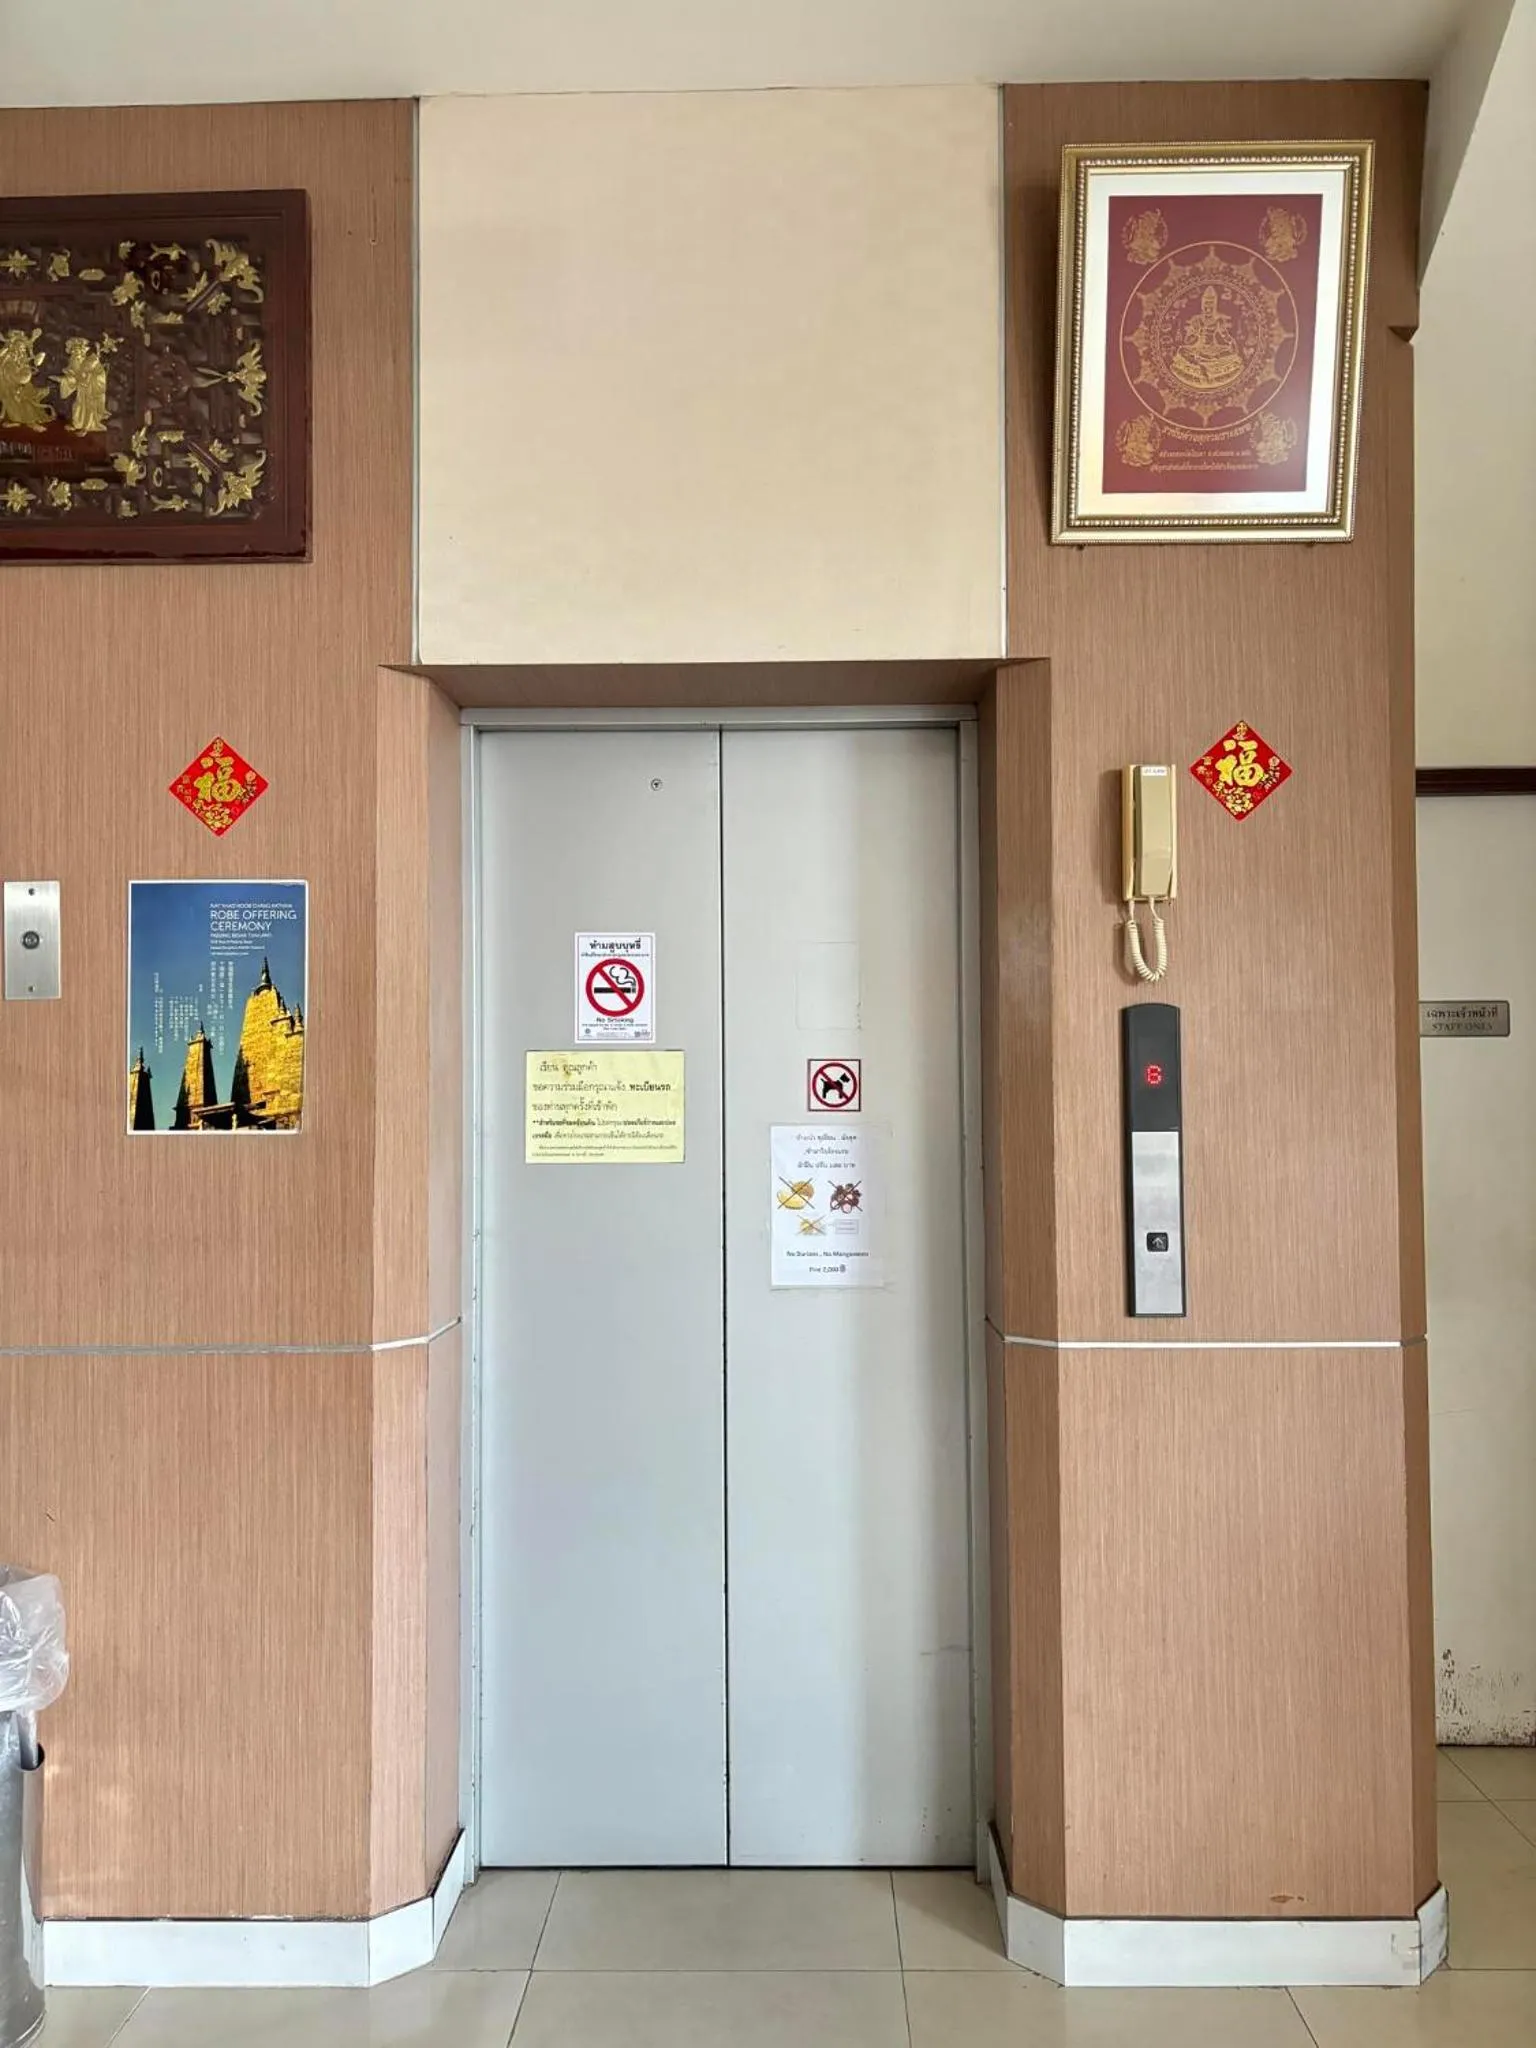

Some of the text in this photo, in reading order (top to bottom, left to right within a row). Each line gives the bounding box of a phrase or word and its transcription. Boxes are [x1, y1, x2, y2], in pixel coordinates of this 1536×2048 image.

[1215, 739, 1264, 787] 福
[194, 756, 242, 802] 福
[210, 910, 297, 920] ROBE OFFERING
[210, 921, 272, 931] CEREMONY
[590, 937, 641, 953] ห้ามสูบบุหรี่
[1427, 1005, 1498, 1018] เฉพาะเจ้าหน้าที่
